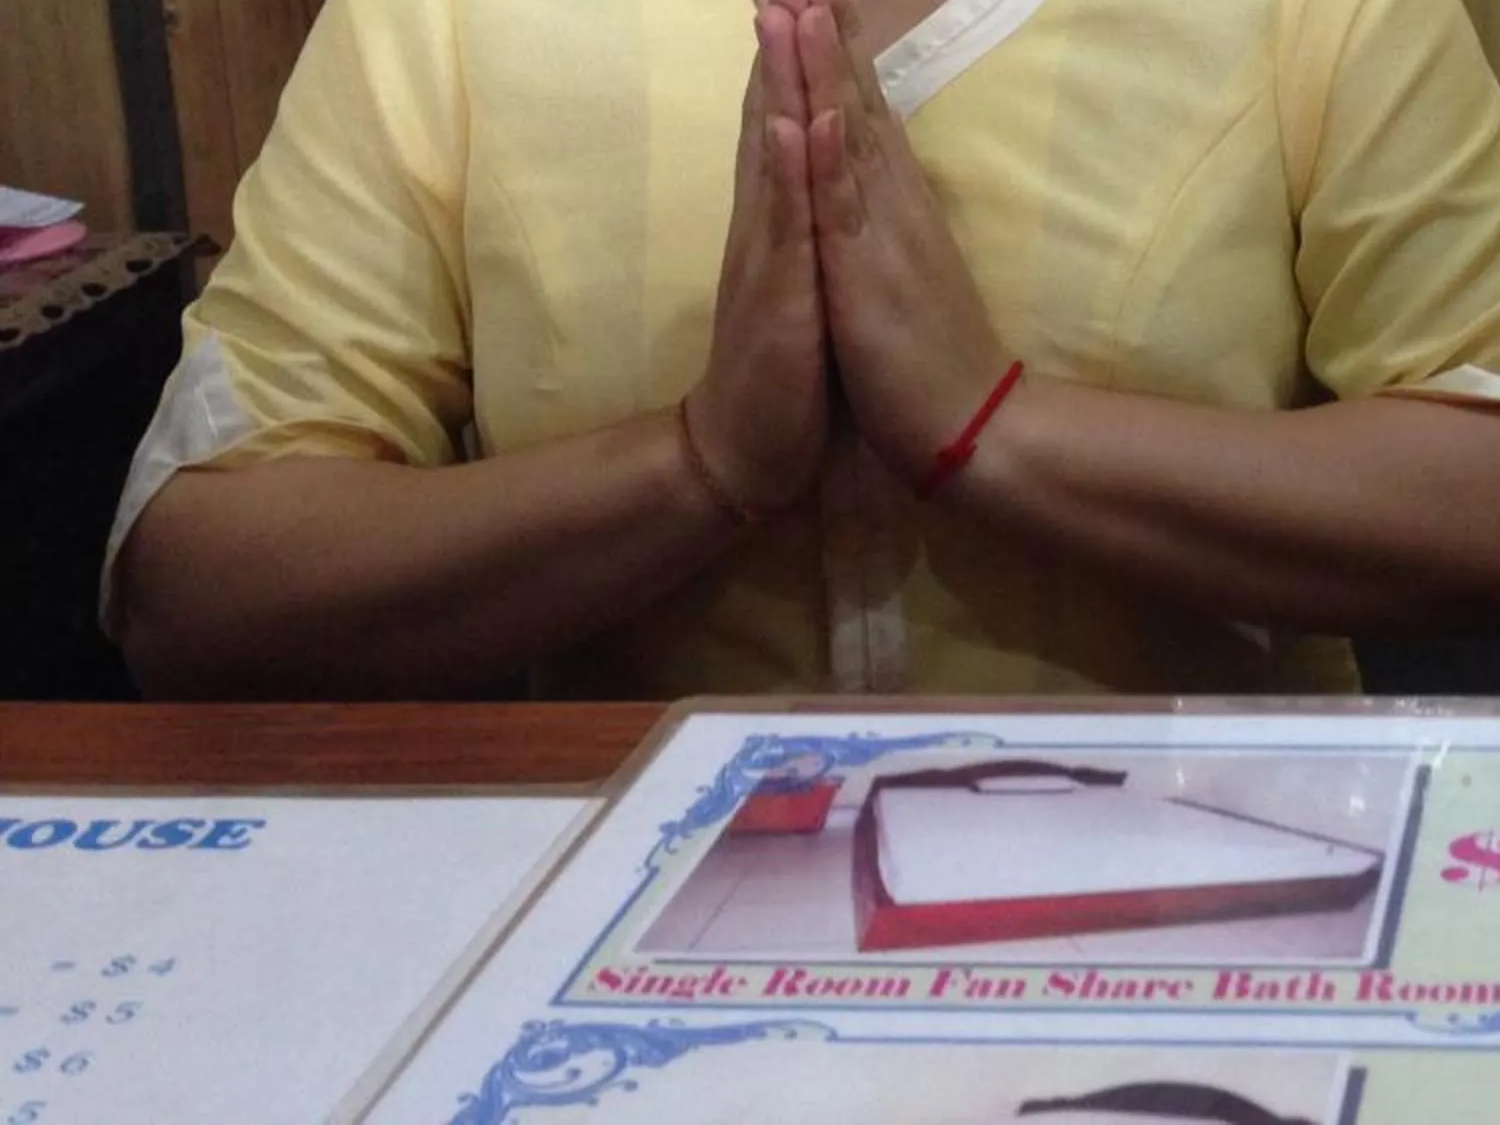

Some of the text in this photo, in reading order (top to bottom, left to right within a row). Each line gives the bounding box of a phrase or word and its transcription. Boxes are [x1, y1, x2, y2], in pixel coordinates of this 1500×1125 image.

[0, 818, 267, 851] OUSE
[593, 967, 748, 1002] Single
[762, 967, 912, 998] Room
[928, 968, 1028, 999] Fan
[1042, 969, 1194, 1001] Share
[1211, 970, 1337, 1002] Bath
